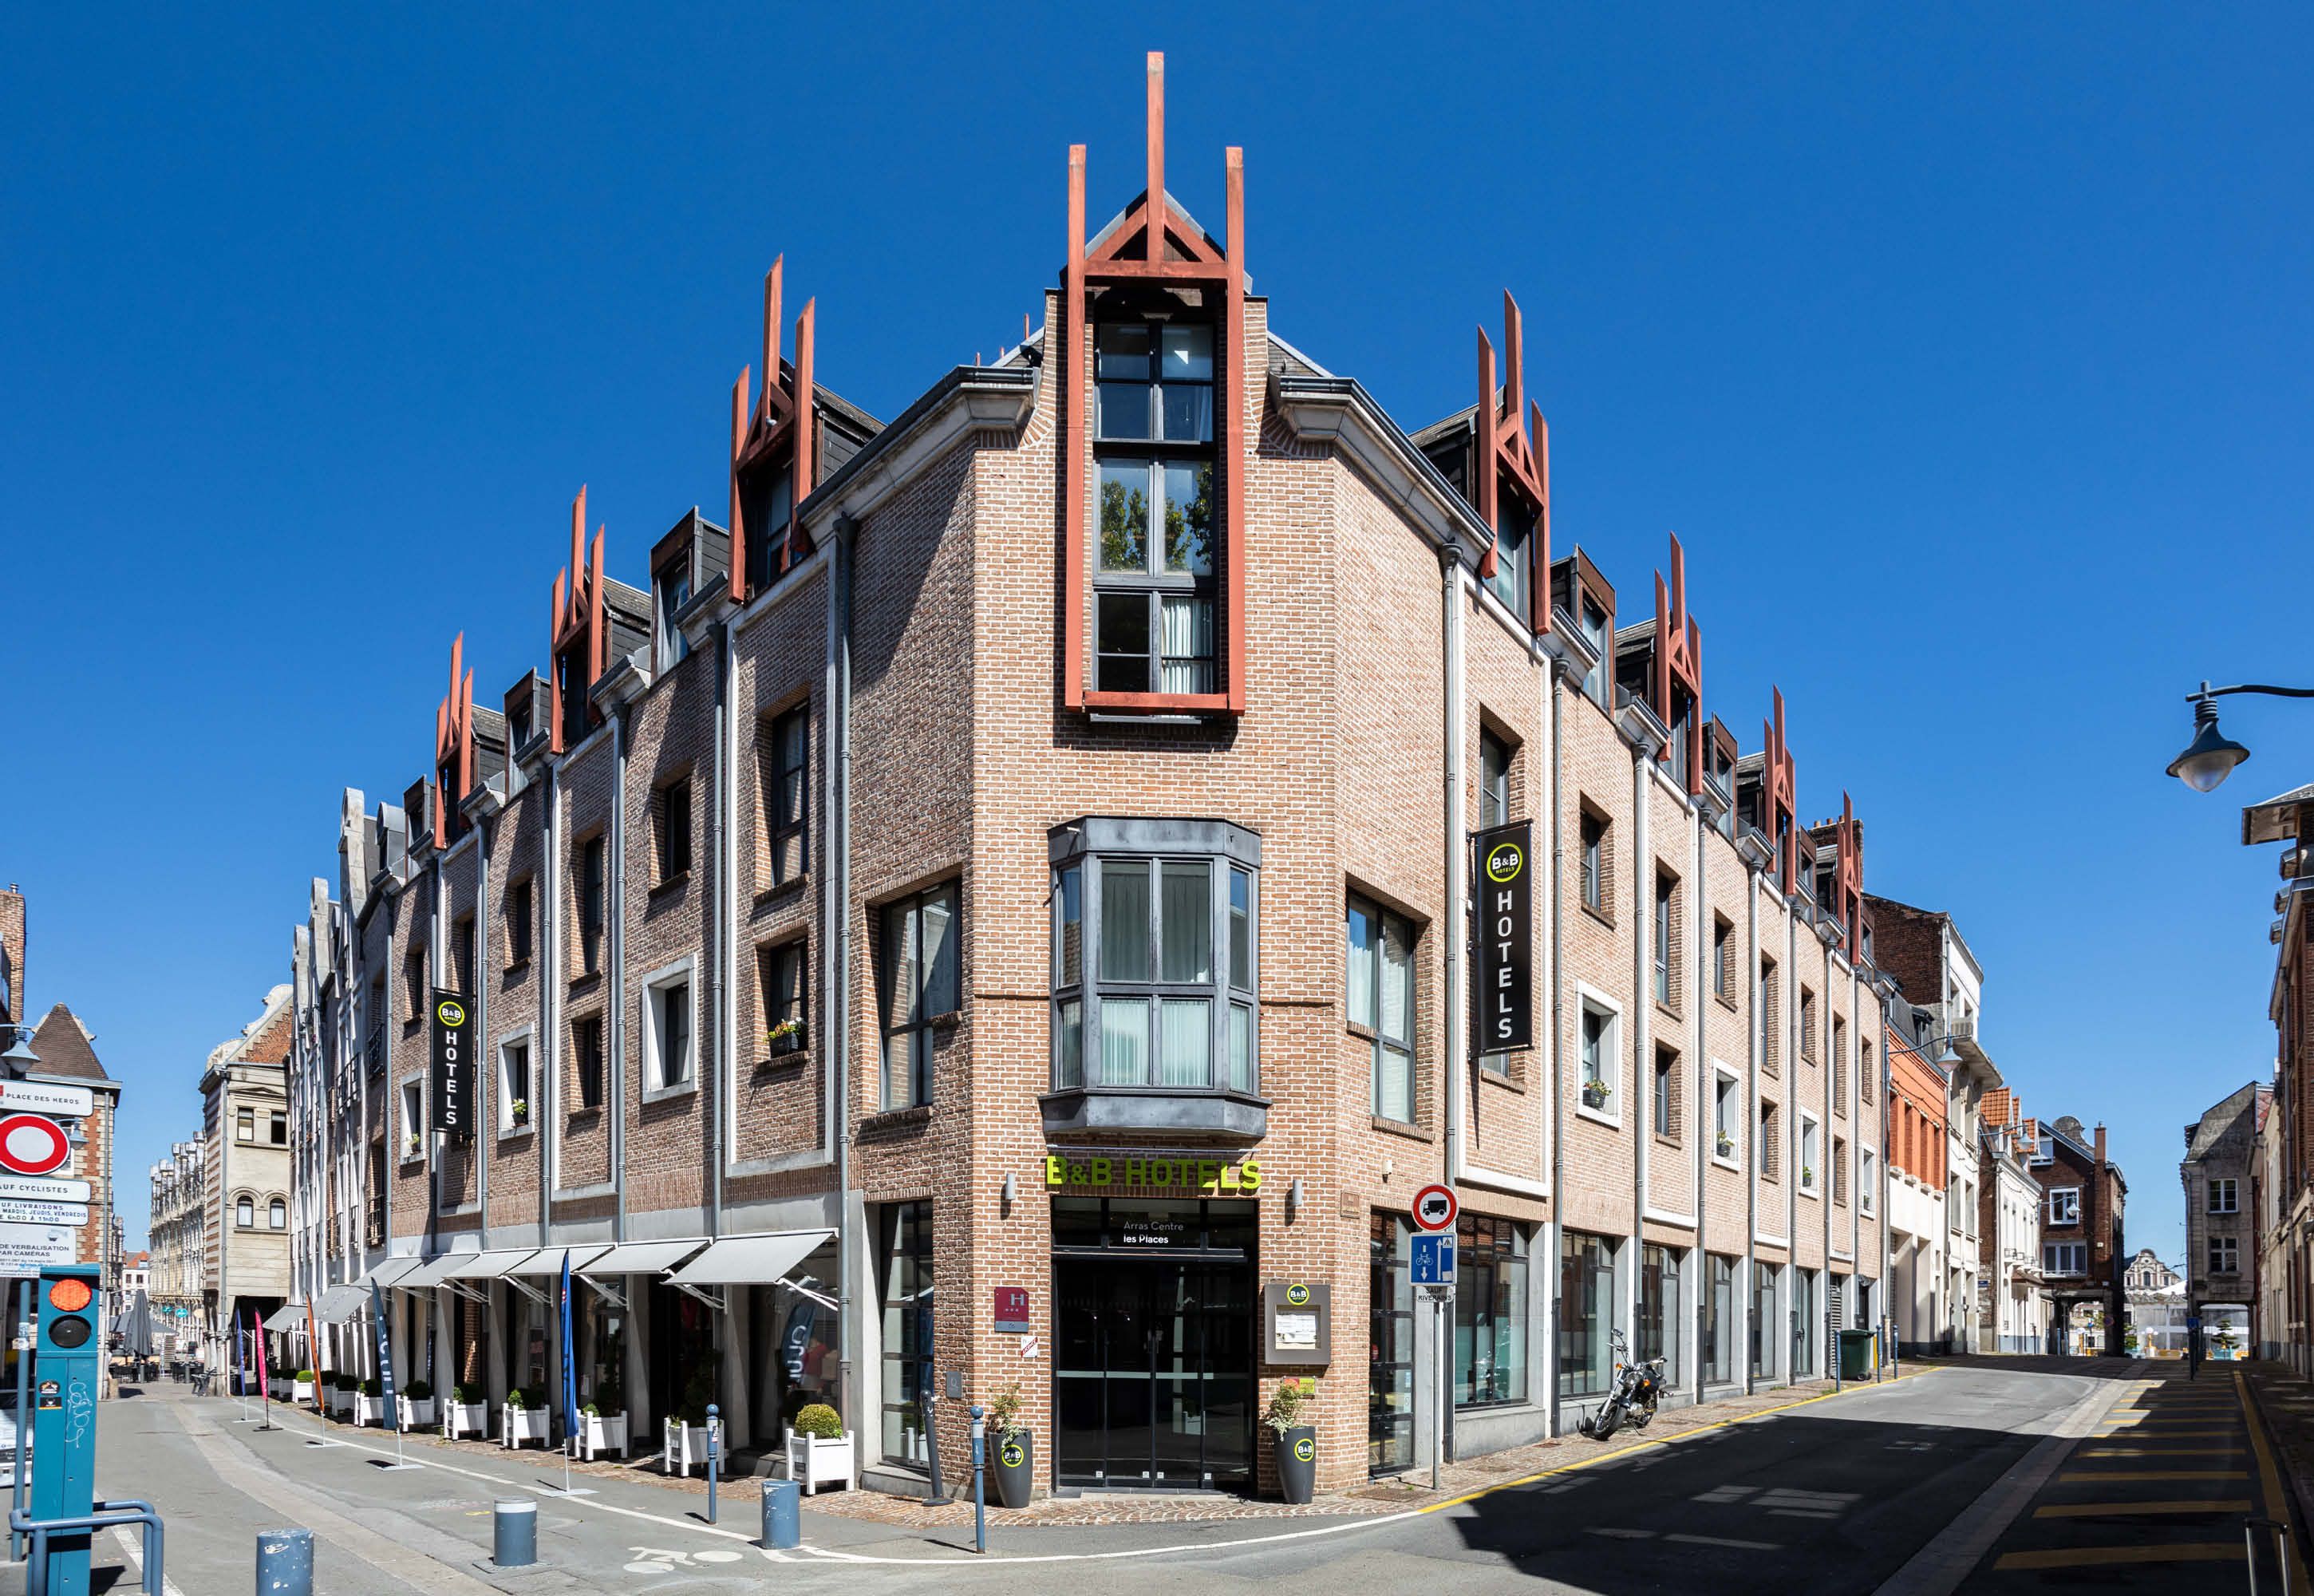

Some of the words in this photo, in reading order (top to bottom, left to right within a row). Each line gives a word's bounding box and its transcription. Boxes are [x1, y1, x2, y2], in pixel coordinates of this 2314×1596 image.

[1492, 853, 1519, 870] B&B
[1497, 889, 1513, 1039] HOTELS
[442, 1007, 461, 1019] B&B
[446, 1030, 457, 1125] HOTELS
[1046, 1156, 1112, 1186] B&B
[1125, 1158, 1262, 1190] HOTELS
[19, 1185, 69, 1194] CYCLISTES
[1123, 1221, 1149, 1230] Arras
[1151, 1221, 1184, 1231] Centre
[1123, 1234, 1137, 1242] les
[1139, 1235, 1169, 1244] Places
[1010, 1294, 1025, 1306] H
